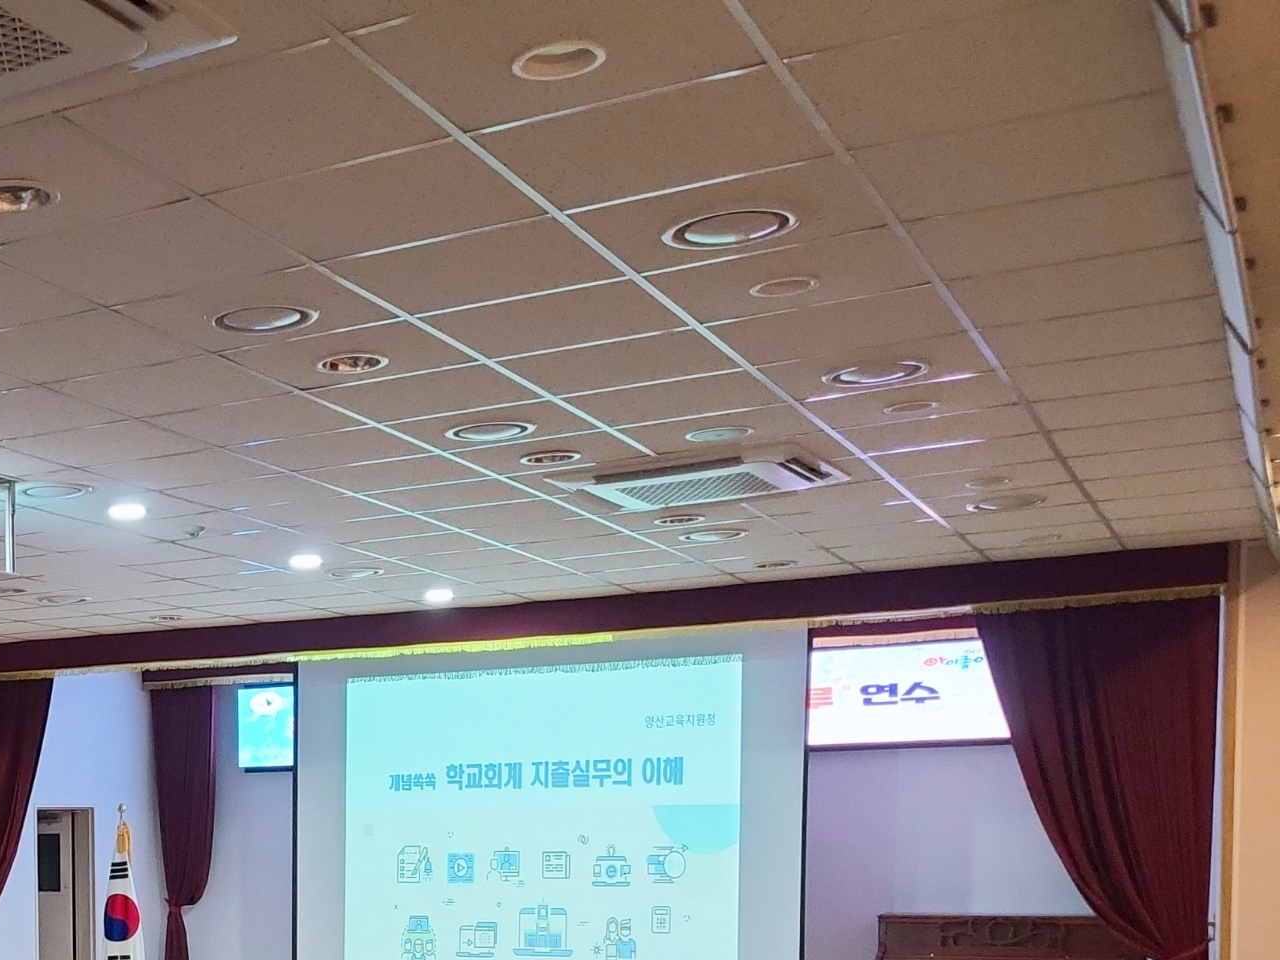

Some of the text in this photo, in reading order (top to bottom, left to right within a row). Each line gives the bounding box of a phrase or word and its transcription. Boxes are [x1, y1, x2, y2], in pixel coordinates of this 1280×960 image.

[860, 682, 940, 706] 연수
[644, 712, 716, 729] 양산교육지원청
[388, 756, 685, 792] 개념쏙쏙 학교회계 지출실무의 이해
